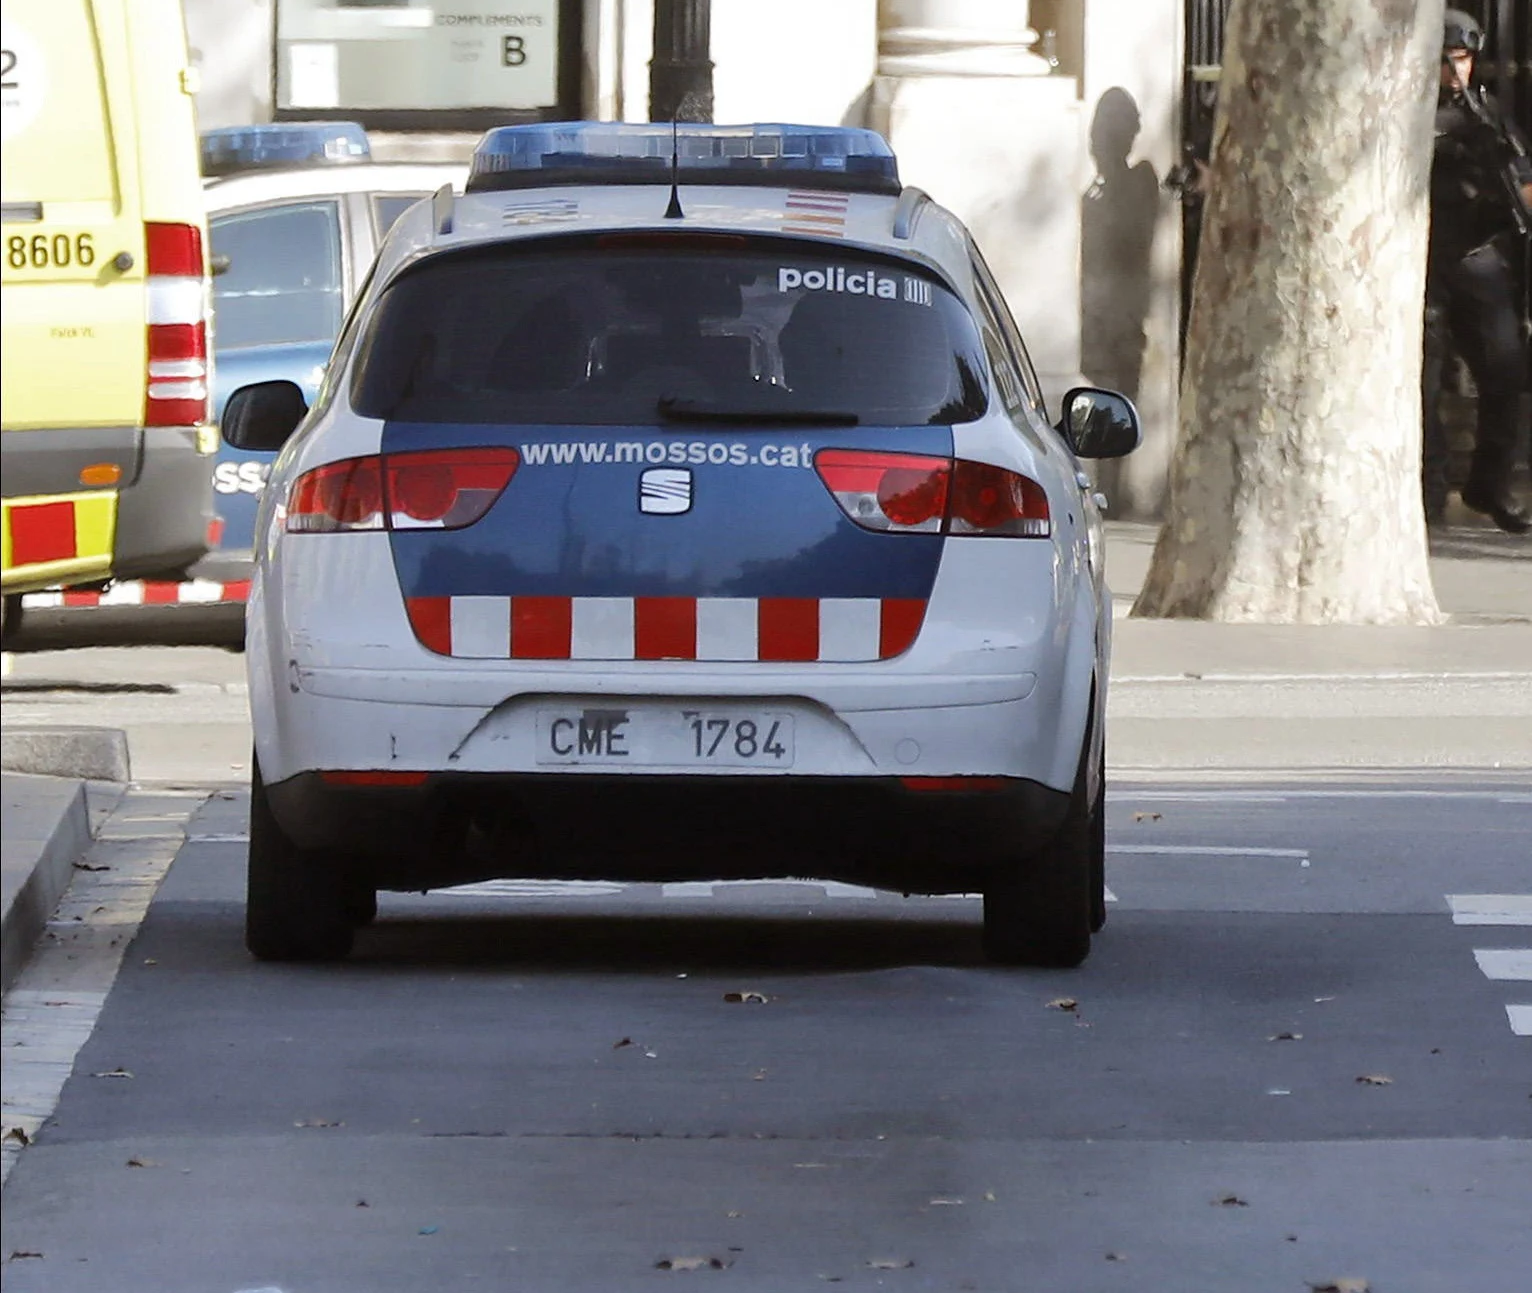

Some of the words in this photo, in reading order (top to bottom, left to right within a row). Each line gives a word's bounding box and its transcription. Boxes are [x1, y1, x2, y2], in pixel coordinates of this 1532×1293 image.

[502, 35, 527, 66] B
[7, 233, 96, 269] 8606
[520, 442, 812, 469] www.mossos.cat
[551, 717, 629, 758] CME
[690, 718, 786, 759] 1784
